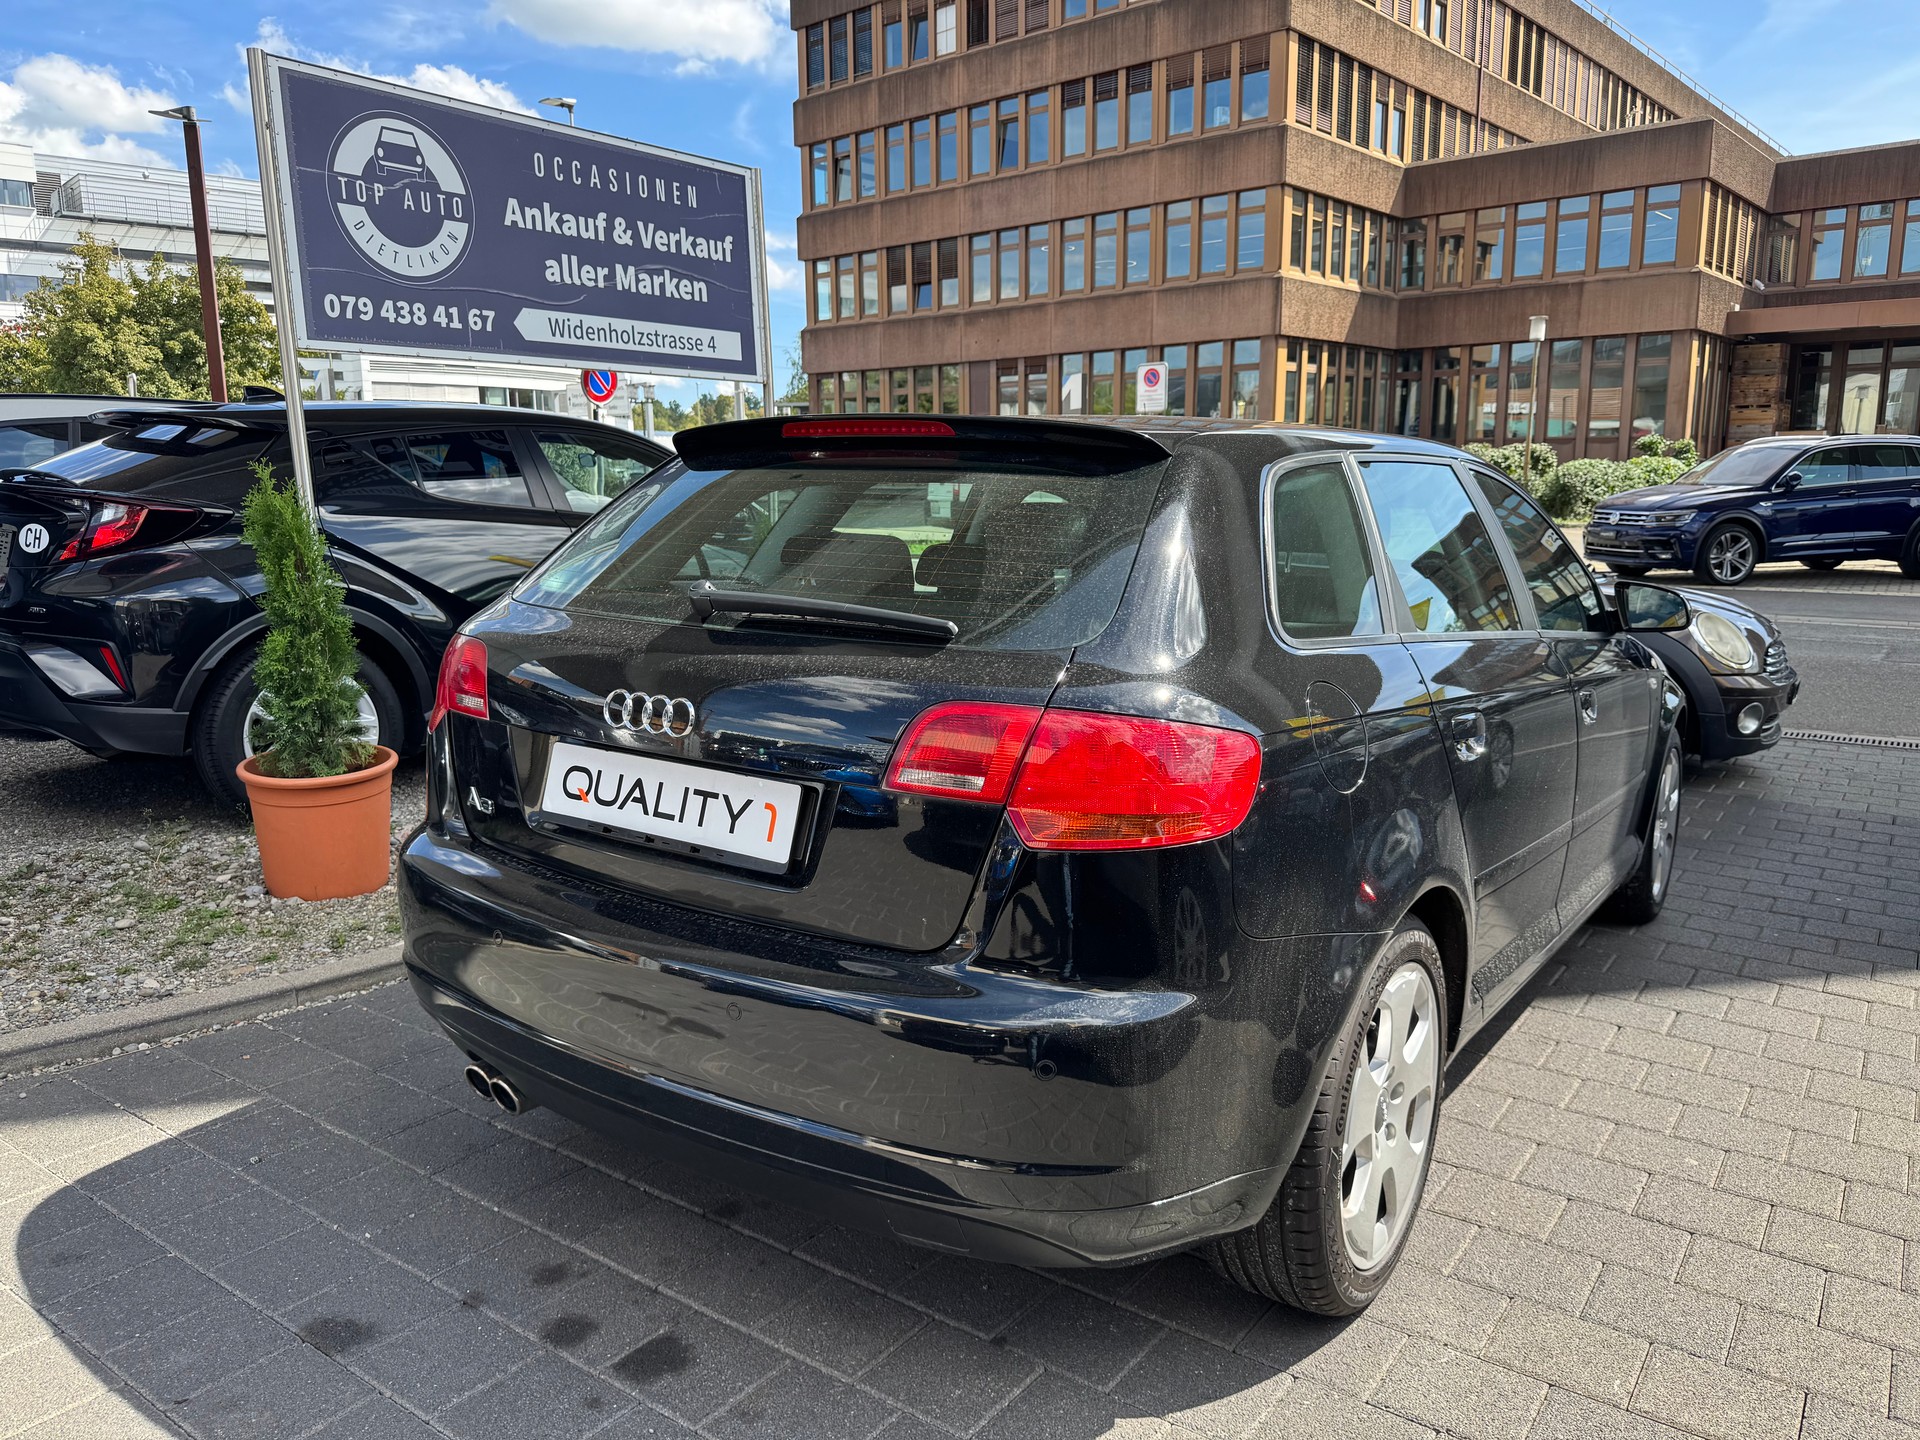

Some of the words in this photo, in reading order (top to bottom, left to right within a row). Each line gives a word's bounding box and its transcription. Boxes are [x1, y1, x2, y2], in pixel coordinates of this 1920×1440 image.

[337, 176, 384, 205] TOP
[403, 188, 463, 219] AUTO
[533, 152, 697, 209] OCCASIONEN
[353, 220, 459, 268] DIETLIKON
[503, 197, 607, 242] Ankauf
[612, 216, 634, 247] &
[636, 220, 734, 263] Verkauf
[544, 253, 609, 289] aller
[614, 263, 708, 303] Marken
[323, 293, 374, 321] 079
[380, 299, 427, 326] 438
[432, 305, 463, 329] 41
[467, 308, 496, 332] 67
[547, 317, 704, 352] Widenholzstrasse
[707, 335, 717, 353] 4
[24, 527, 43, 549] CH
[1335, 1021, 1365, 1137] Continental
